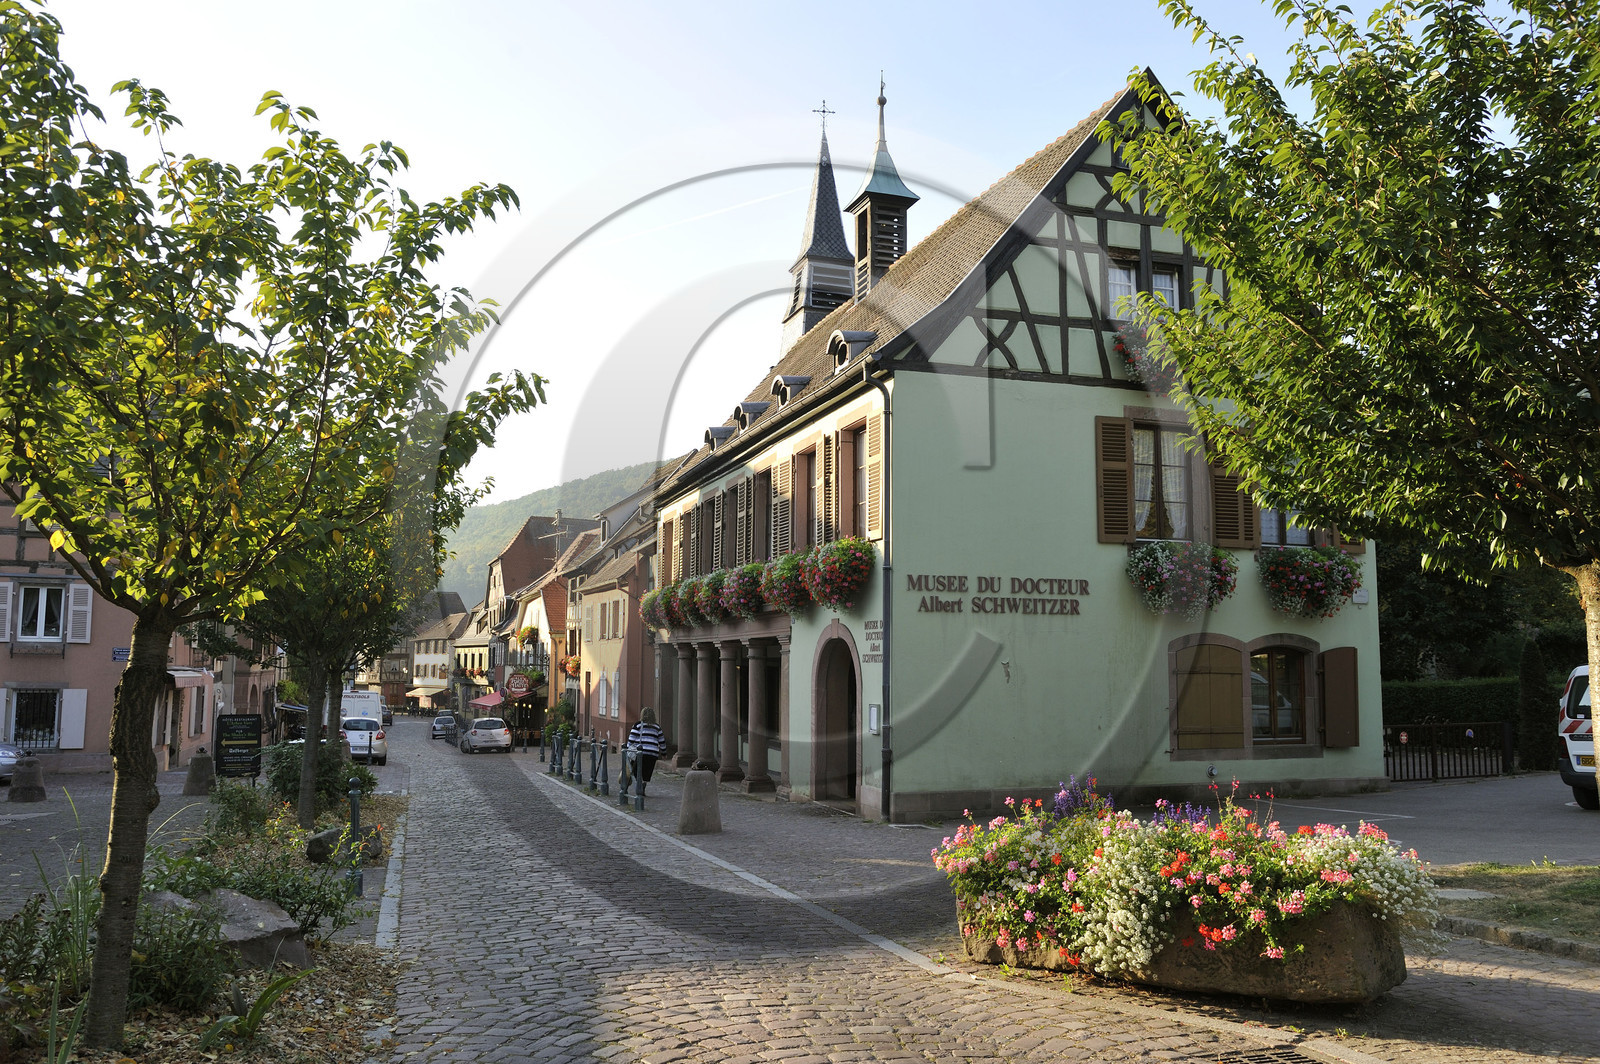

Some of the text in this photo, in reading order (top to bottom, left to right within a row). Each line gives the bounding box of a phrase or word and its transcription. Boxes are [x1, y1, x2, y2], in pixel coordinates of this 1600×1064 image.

[906, 574, 1090, 596] MUSEE DU DOCTEUR
[917, 596, 1081, 616] Albert SCHWEITZER
[865, 631, 884, 642] DOCTEU
